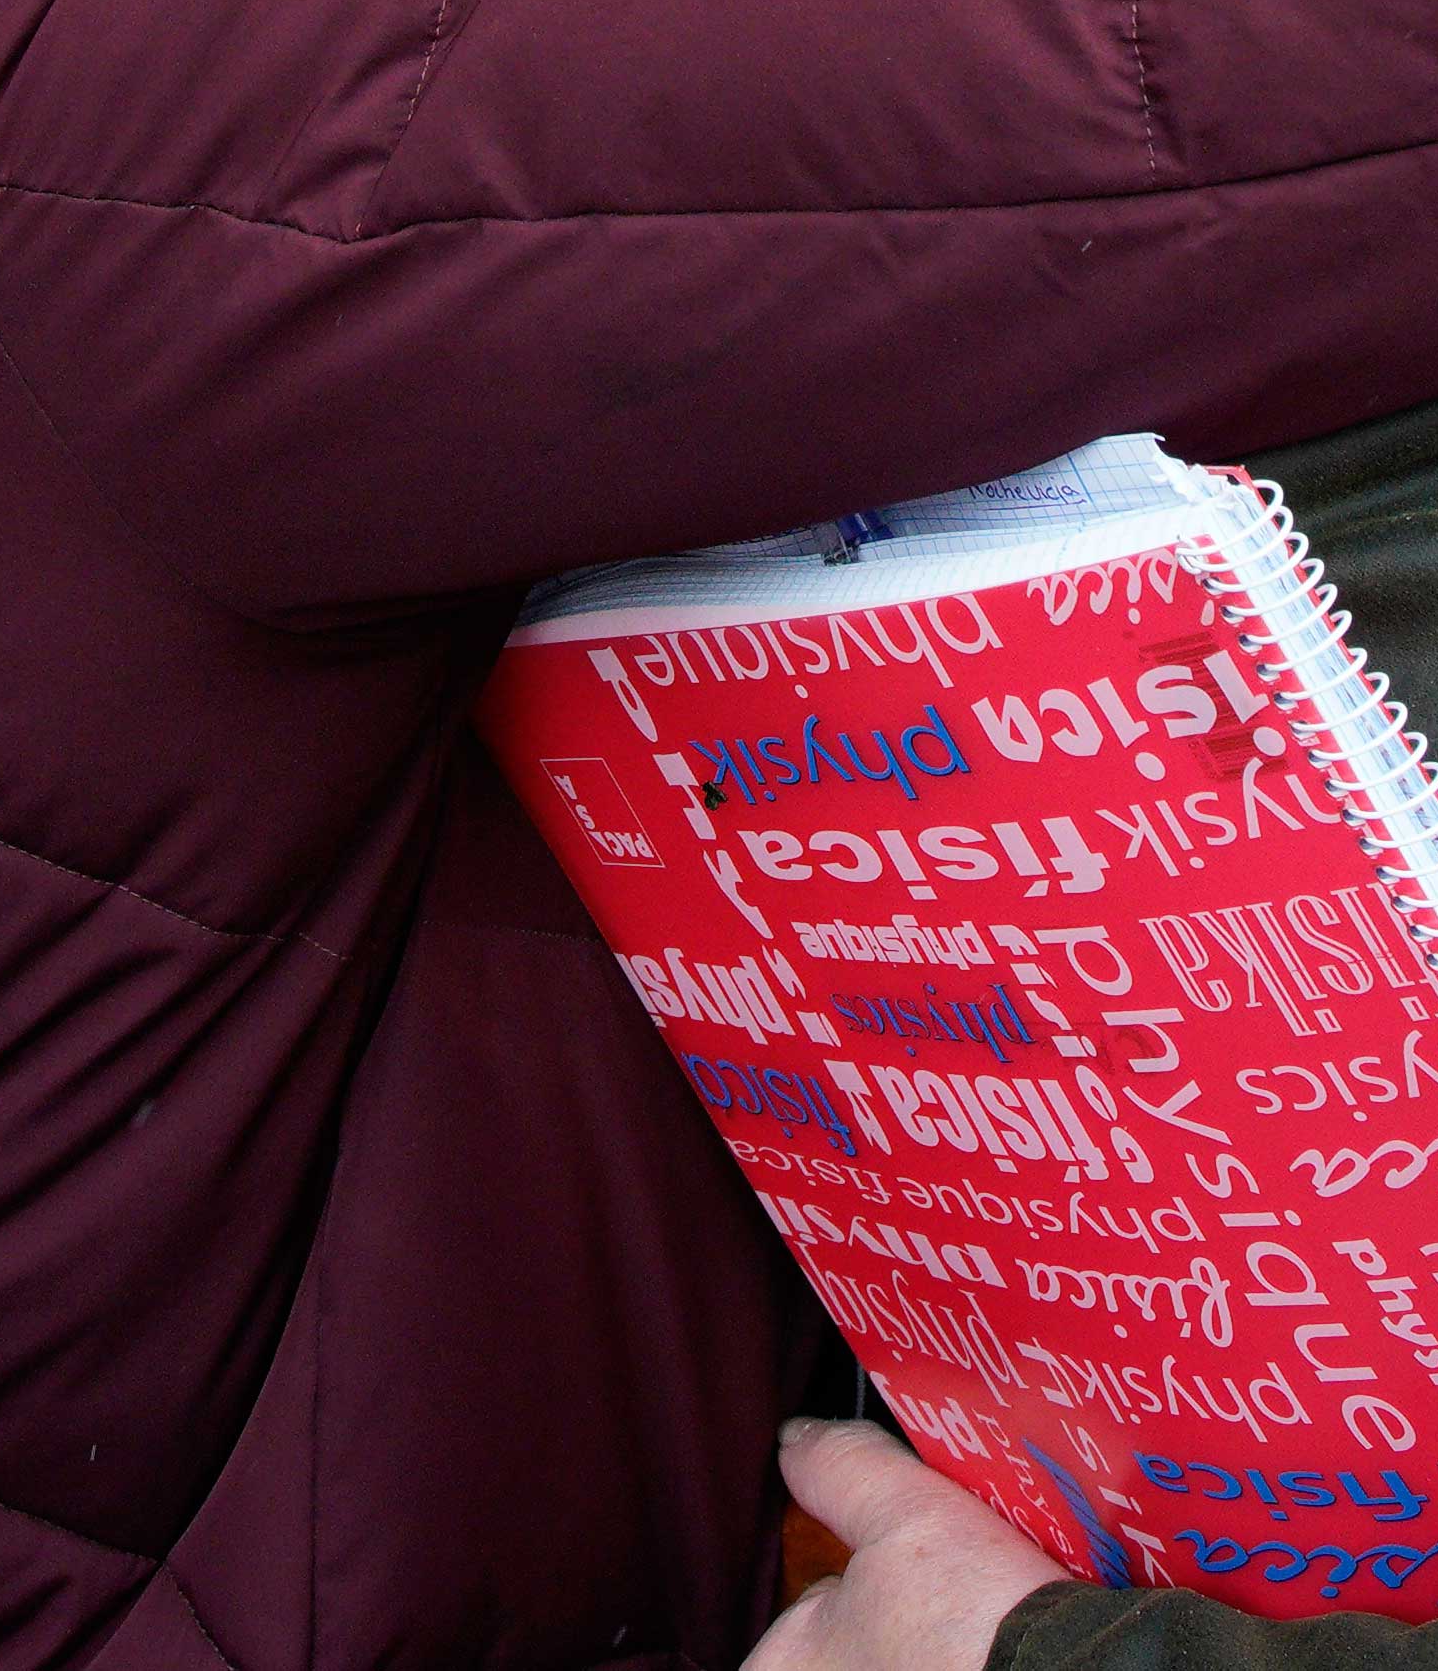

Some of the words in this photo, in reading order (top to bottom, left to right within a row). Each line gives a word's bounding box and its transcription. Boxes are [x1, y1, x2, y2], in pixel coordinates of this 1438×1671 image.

[1026, 550, 1225, 628] sica
[689, 704, 971, 805] physik
[736, 816, 1110, 900] física
[791, 914, 995, 971] physique
[830, 983, 1037, 1064] physics
[870, 1065, 1110, 1183] física
[896, 1175, 1207, 1254] physique
[1016, 1257, 1234, 1348] física
[1061, 1353, 1313, 1443] physik
